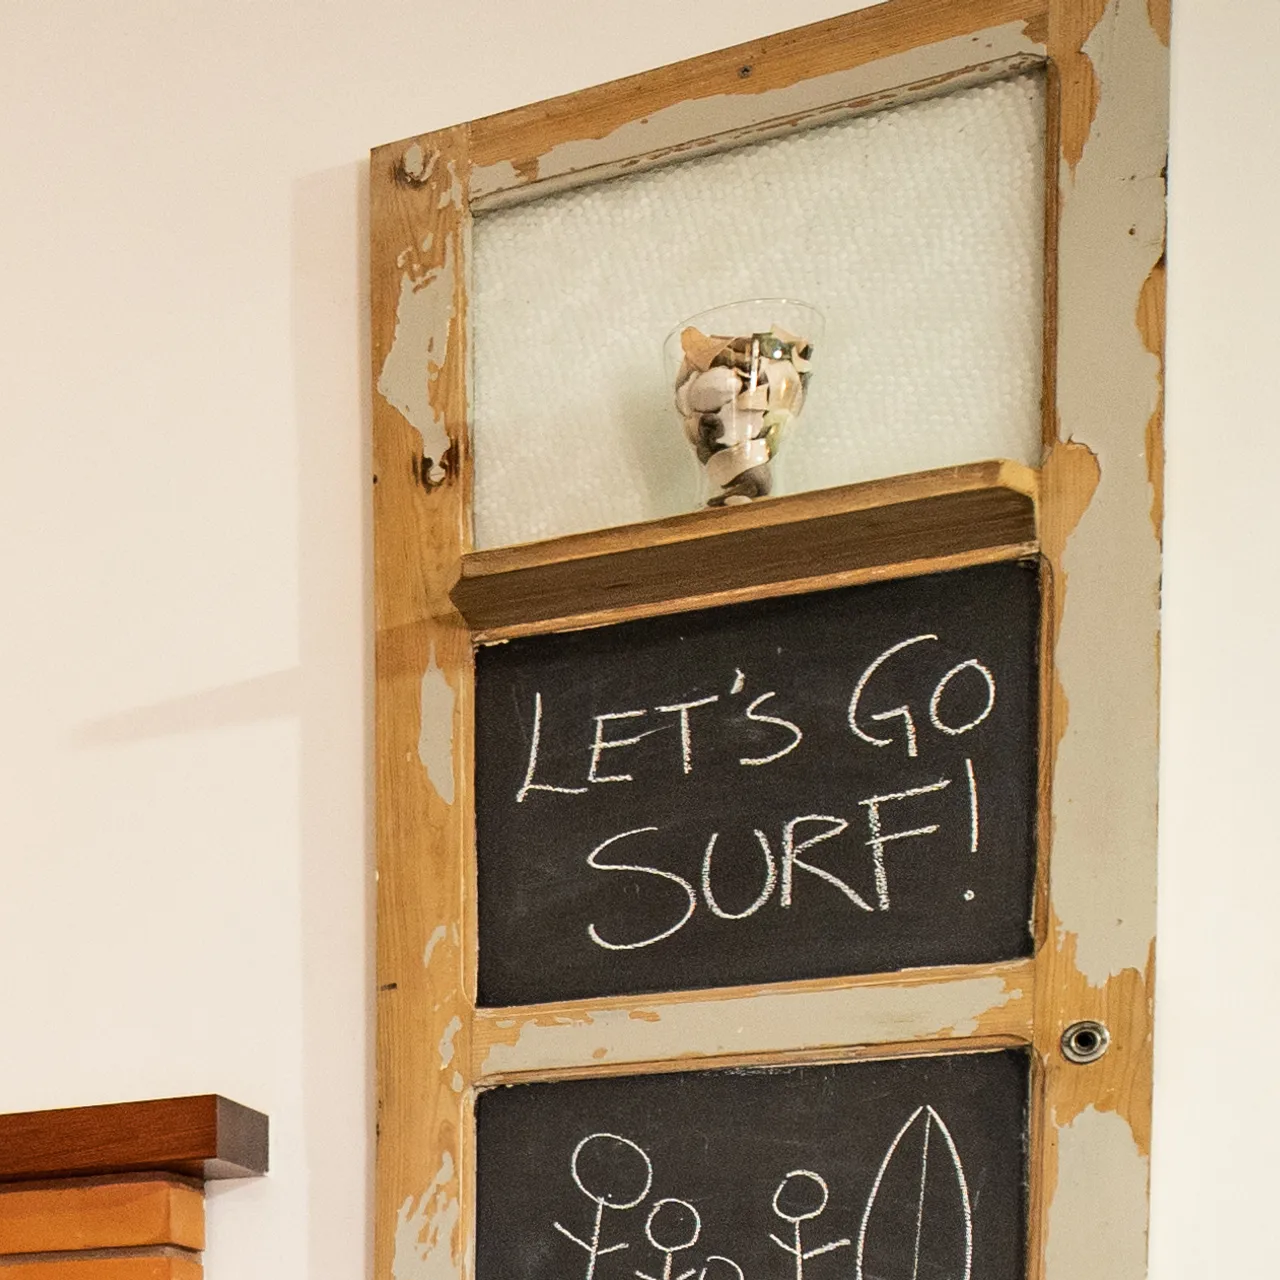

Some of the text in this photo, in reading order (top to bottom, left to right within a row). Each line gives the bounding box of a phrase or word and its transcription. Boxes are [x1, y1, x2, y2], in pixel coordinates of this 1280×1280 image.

[516, 634, 996, 802] LET'S GO
[587, 758, 979, 950] SURF!
